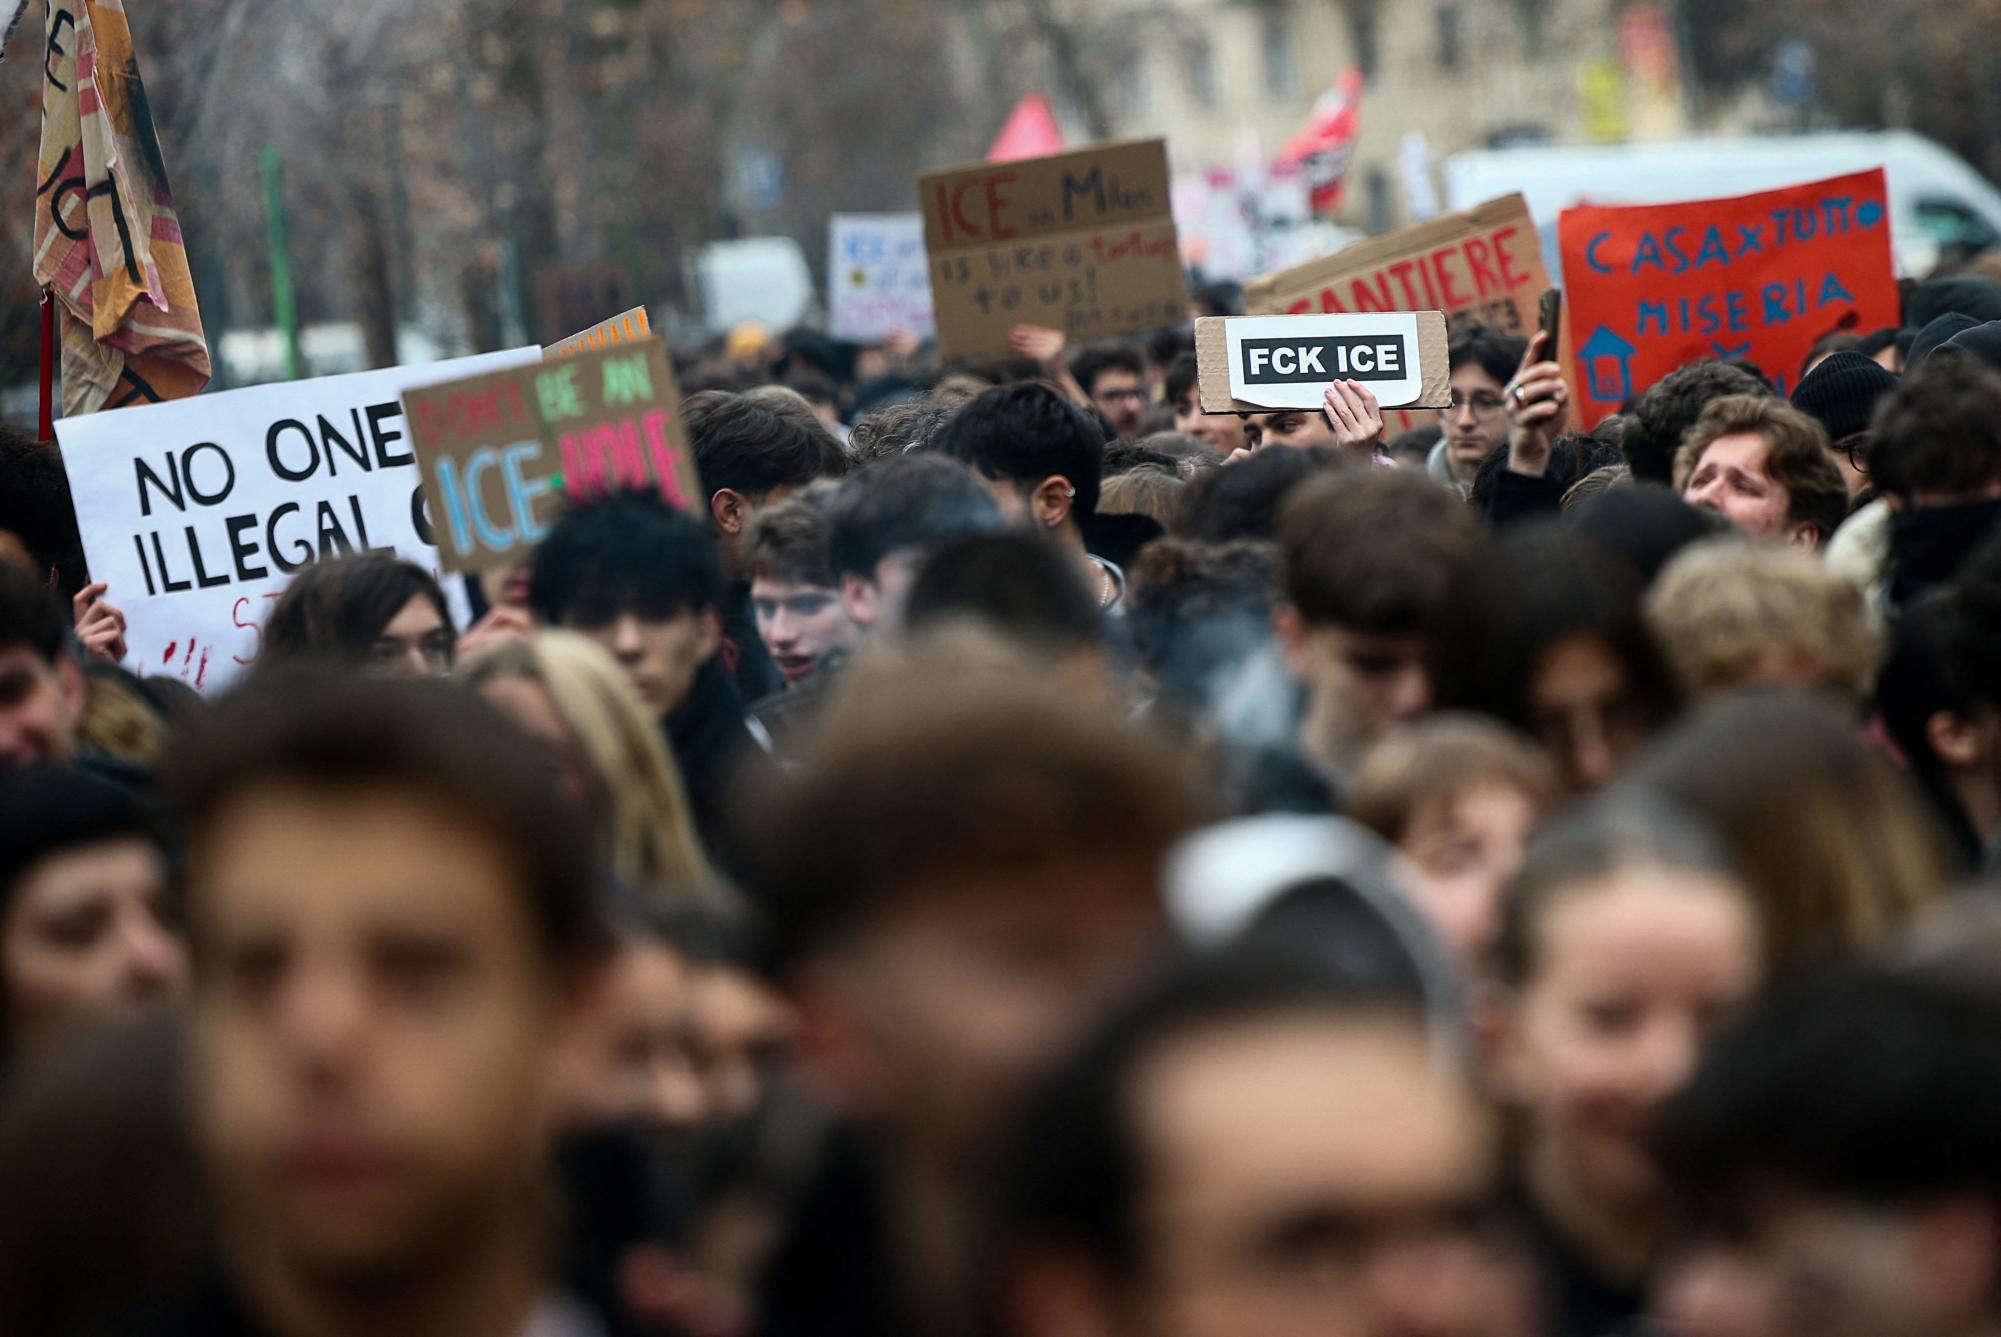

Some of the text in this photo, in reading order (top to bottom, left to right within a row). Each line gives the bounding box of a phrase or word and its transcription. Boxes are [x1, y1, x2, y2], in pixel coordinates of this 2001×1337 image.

[935, 170, 1018, 242] ICE
[1586, 225, 1730, 275] CASA
[1637, 272, 1855, 334] MISERIA
[535, 362, 588, 422] BE
[601, 351, 654, 406] AN
[1250, 344, 1400, 375] FCK ICE
[134, 400, 416, 516] NO ONE
[134, 495, 396, 596] ILLEGAL
